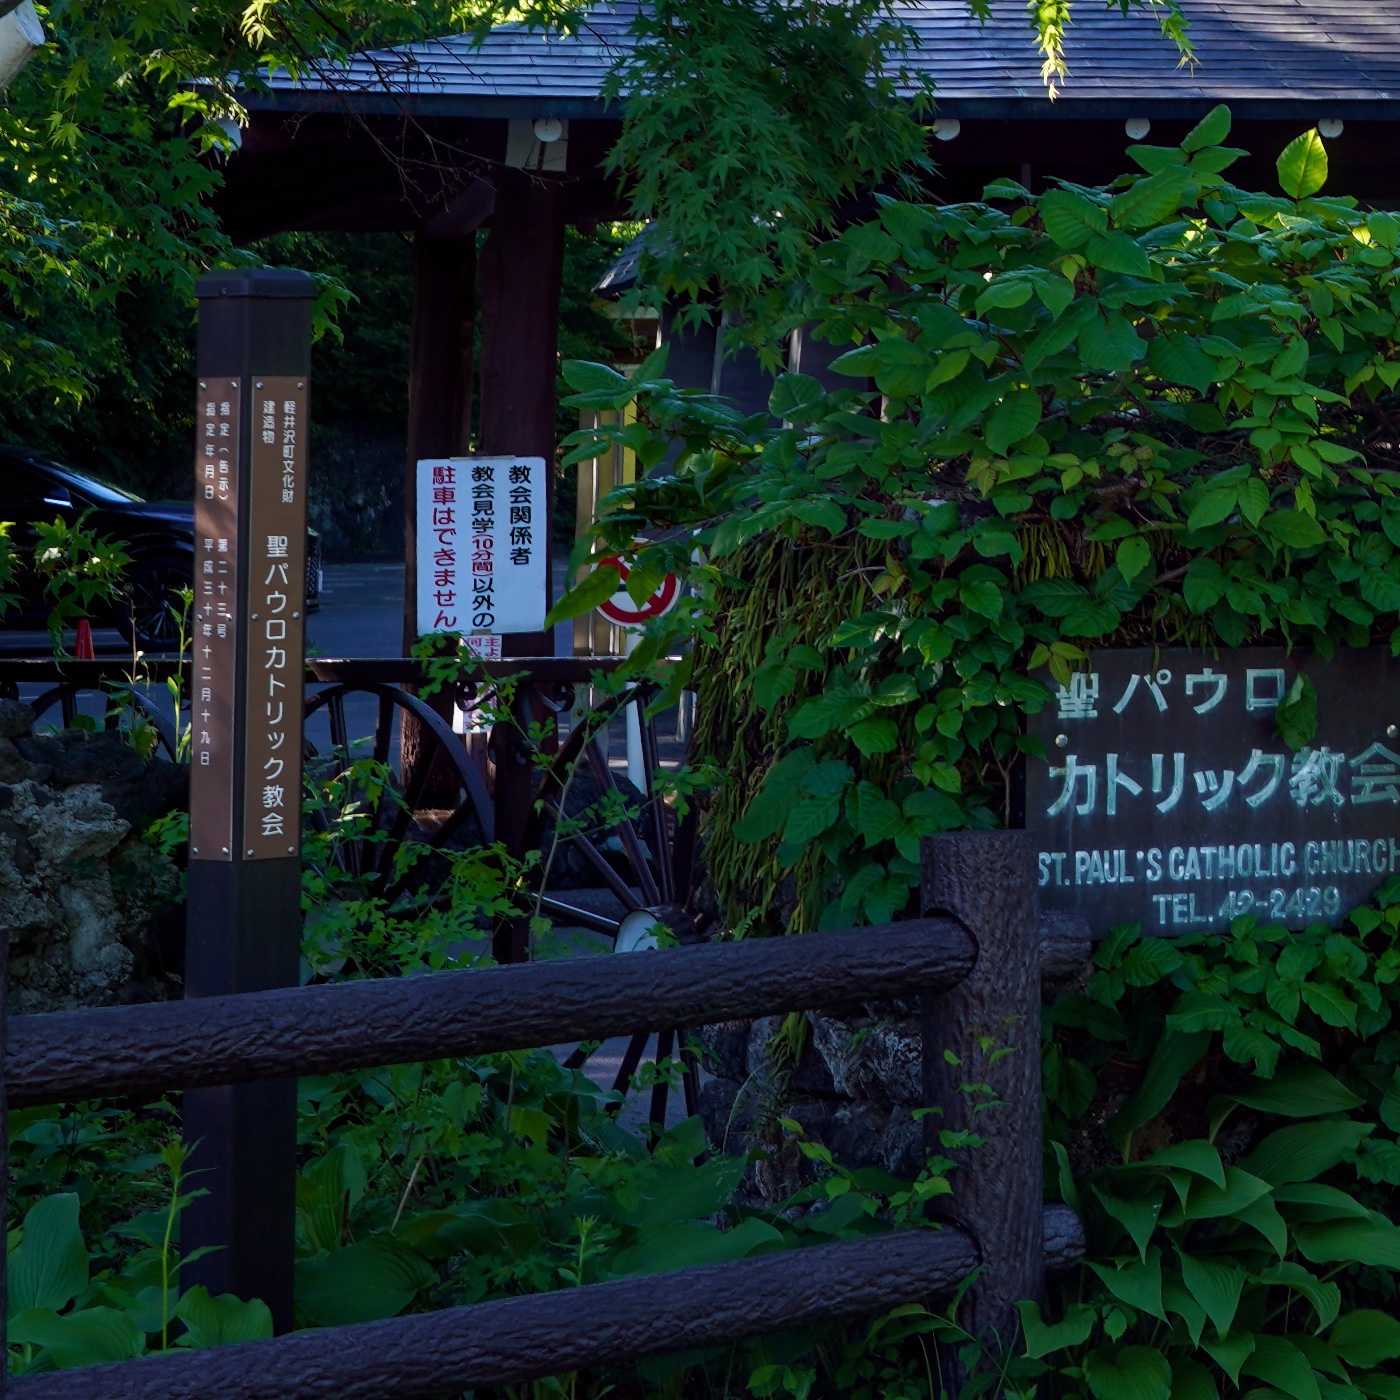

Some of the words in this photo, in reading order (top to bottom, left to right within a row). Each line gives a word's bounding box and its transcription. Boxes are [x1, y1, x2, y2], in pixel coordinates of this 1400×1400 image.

[204, 401, 217, 500] 指定年月日
[262, 400, 276, 444] 建造物
[281, 400, 296, 504] 軽井沢町文化財
[432, 465, 457, 629] 駐車はできません
[509, 465, 532, 565] 教会関係者
[216, 538, 228, 639] 第二十三号
[199, 538, 215, 766] 平成三十年十二月十九日
[260, 534, 290, 838] 聖パウロカトリック教会
[1056, 667, 1286, 720] 聖パウロ
[1037, 851, 1070, 887] ST.
[1168, 841, 1297, 881] CATHOLIC
[1152, 892, 1213, 925] TEL.
[1218, 885, 1341, 921] 42-2429
